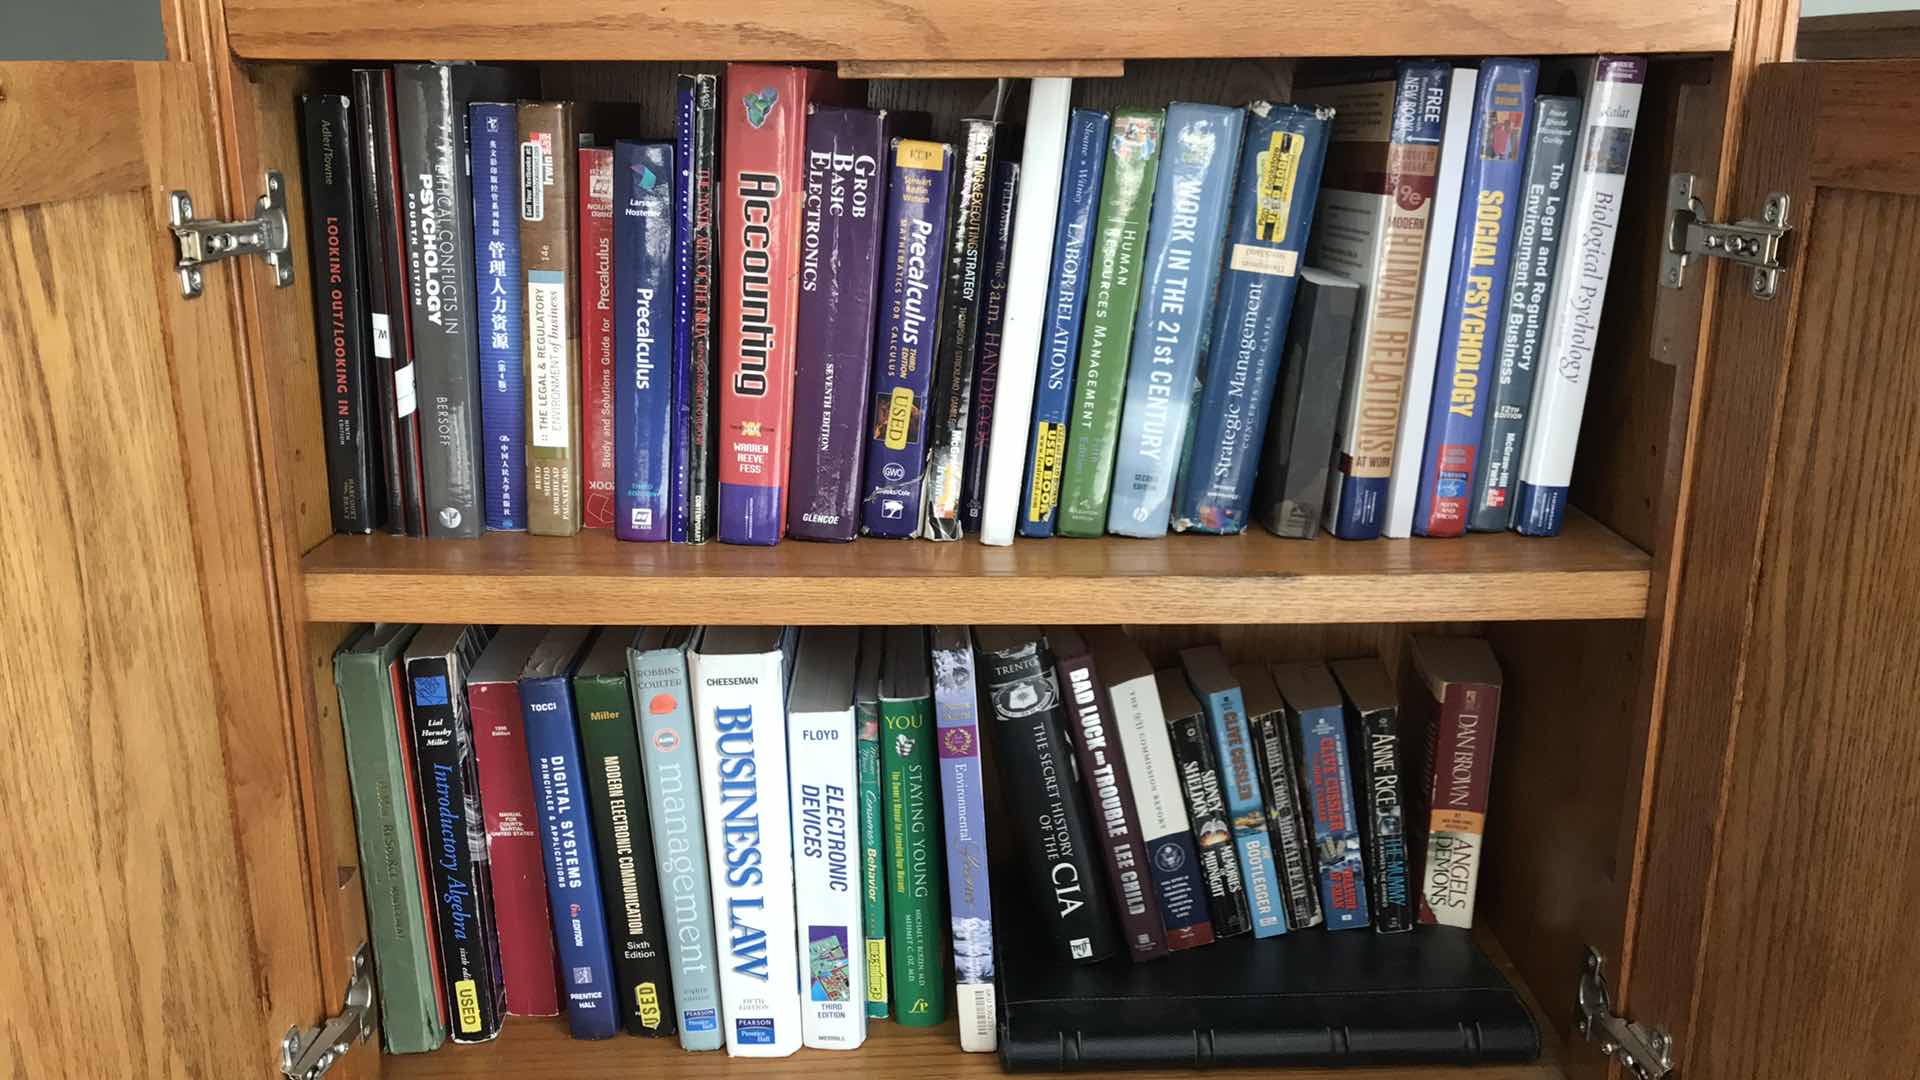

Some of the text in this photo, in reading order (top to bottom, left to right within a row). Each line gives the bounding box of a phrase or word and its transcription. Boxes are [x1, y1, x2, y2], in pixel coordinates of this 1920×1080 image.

[1404, 76, 1421, 100] NEW
[1424, 86, 1445, 123] FREE
[829, 152, 855, 217] BASIC
[1171, 180, 1204, 244] WORK
[1401, 185, 1422, 206] 9e
[409, 192, 423, 306] FOURTH EDITION
[419, 174, 442, 326] PSYCHOLOGY
[803, 149, 832, 292] ELECTRONICS
[438, 230, 459, 312] CONFLICTS
[732, 172, 783, 397] Accounting
[902, 218, 934, 346] Precalculus
[962, 250, 979, 302] STRATEGY
[1060, 223, 1084, 288] LABOR
[1117, 230, 1138, 287] HUMAN
[1167, 248, 1194, 271] IN
[1376, 232, 1423, 319] HUMAN
[1498, 183, 1546, 385] Environment of Business
[1517, 163, 1566, 370] The Legal and Regulatory
[1558, 191, 1615, 384] Biological Psychology
[326, 217, 344, 284] LOOKING
[338, 400, 350, 415] IN
[445, 319, 459, 334] IN
[887, 219, 908, 378] MATHEMATICS FOR CALCULUS
[1160, 277, 1189, 316] THE
[1448, 190, 1505, 417] SOCIAL PSYCHOLOGY
[535, 288, 549, 431] THE LEGAL REGULATORY
[546, 290, 562, 432] ENVIRONMENT business
[594, 238, 614, 469] Study and Solutions Guide for Precalculus
[636, 287, 656, 389] Precalculus
[908, 347, 918, 373] THIRD
[1047, 290, 1078, 392] RELATIONS
[1080, 228, 1122, 431] RESOURCES MANAGEMENT
[1153, 320, 1181, 365] 21st
[899, 346, 911, 379] EDITION
[974, 331, 1001, 451] HANDBOOK
[1212, 281, 1263, 481] Strategic Management
[1358, 331, 1411, 453] RELATIONS
[436, 397, 449, 448] BERSOFF
[821, 362, 835, 451] SEVENTH EDITION
[887, 395, 910, 442] USED
[1138, 370, 1174, 461] CENTURY
[1046, 429, 1058, 468] USED
[1487, 462, 1502, 488] Irwin
[1498, 432, 1516, 488] McGraw-Hill
[552, 466, 561, 515] MOREHEAD
[802, 512, 840, 526] GLENCOE
[638, 668, 681, 679] ROBBINS
[639, 678, 682, 691] COULTER
[706, 677, 759, 687] CHEESEMAN
[996, 660, 1040, 674] TRENTO
[421, 729, 453, 738] Hornsby
[427, 719, 444, 728] Lial
[530, 702, 557, 712] TOCCI
[591, 710, 620, 721] Miller
[803, 730, 839, 741] FLOYD
[885, 714, 923, 729] YOU
[1456, 713, 1480, 750] DAN
[425, 739, 449, 748] Miller
[1128, 690, 1168, 831] THE COMMISSION REPORT
[1371, 733, 1399, 805] ANNE RICE
[955, 763, 973, 842] Environmental
[1032, 722, 1074, 858] THE SECRET HISTORY
[1069, 667, 1148, 916] BAD LUCK TROUBLE LEE CHILD
[1182, 759, 1209, 821] SHELDON
[1200, 768, 1225, 814] SIDNEY
[1448, 751, 1473, 807] BROWN
[540, 757, 567, 890] PRINCIPLES APPLICATIONS
[550, 755, 583, 890] DIGITAL SYSTEMS
[603, 755, 644, 936] MODERN ELECTRONIC COMMUNICATION
[713, 704, 770, 981] BUSINESS LAW
[801, 784, 823, 858] DEVICES
[826, 785, 849, 891] ELECTRONIC
[908, 765, 929, 898] STAYING YOUNG
[1263, 736, 1306, 900] ROBIN MORTAL FEAR
[432, 762, 472, 941] Introductory Algebra
[662, 762, 708, 975] management
[866, 847, 879, 903] Behavior
[1039, 814, 1086, 920] OF THE CIA
[1201, 849, 1226, 898] MIDNIGHT
[1219, 844, 1244, 894] MEMORIES
[1246, 841, 1271, 915] BOOTLEGGER
[1385, 838, 1407, 906] THE MUMMY
[1431, 835, 1452, 906] DEMONS
[1448, 837, 1474, 909] ANGELS
[572, 919, 585, 948] EDITION
[624, 949, 656, 960] Edition
[626, 940, 651, 950] Sixth
[459, 989, 477, 1026] USED
[569, 991, 603, 1000] PRENTICE
[578, 1001, 597, 1009] HALL
[639, 985, 660, 1028] USED
[738, 1018, 772, 1027] PEARSON
[818, 1010, 847, 1019] EDITION
[821, 1003, 843, 1011] THIRD
